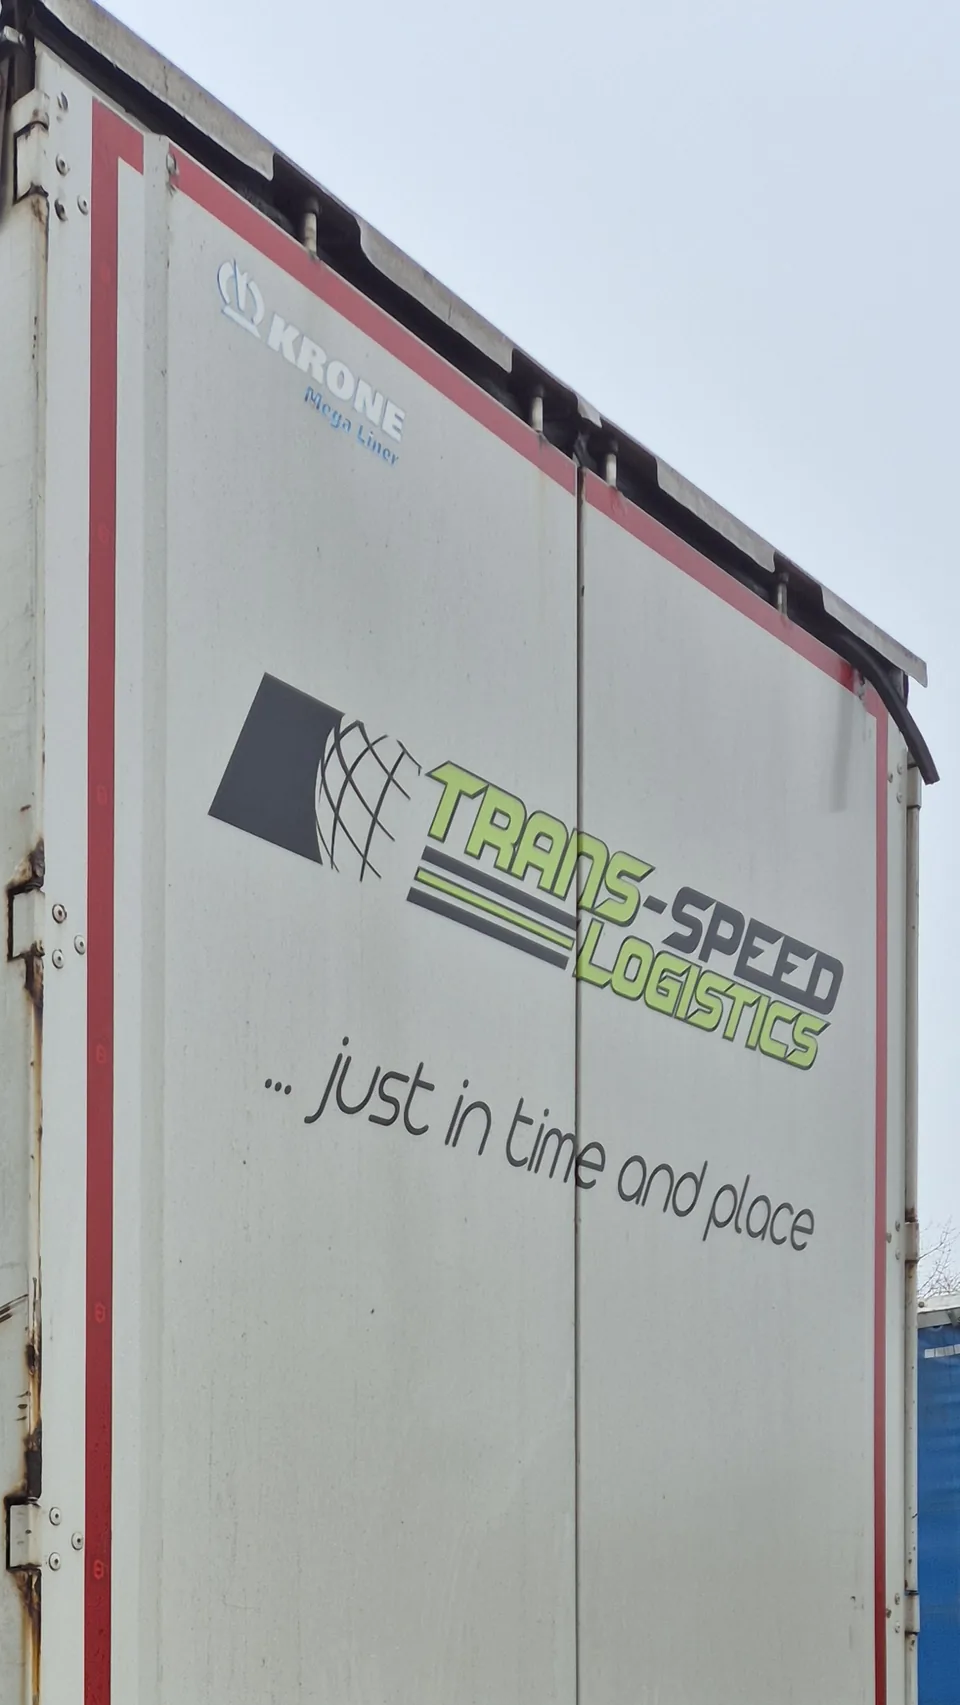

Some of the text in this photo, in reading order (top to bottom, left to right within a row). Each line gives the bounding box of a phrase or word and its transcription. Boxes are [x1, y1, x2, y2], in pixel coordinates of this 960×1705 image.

[268, 313, 406, 443] KRONE
[304, 386, 400, 465] Mega Liner
[572, 918, 831, 1070] LOGISTICS
[304, 1036, 435, 1136] just
[444, 1079, 492, 1156] in
[506, 1097, 606, 1190] time
[617, 1160, 708, 1218] and
[703, 1174, 815, 1251] place
